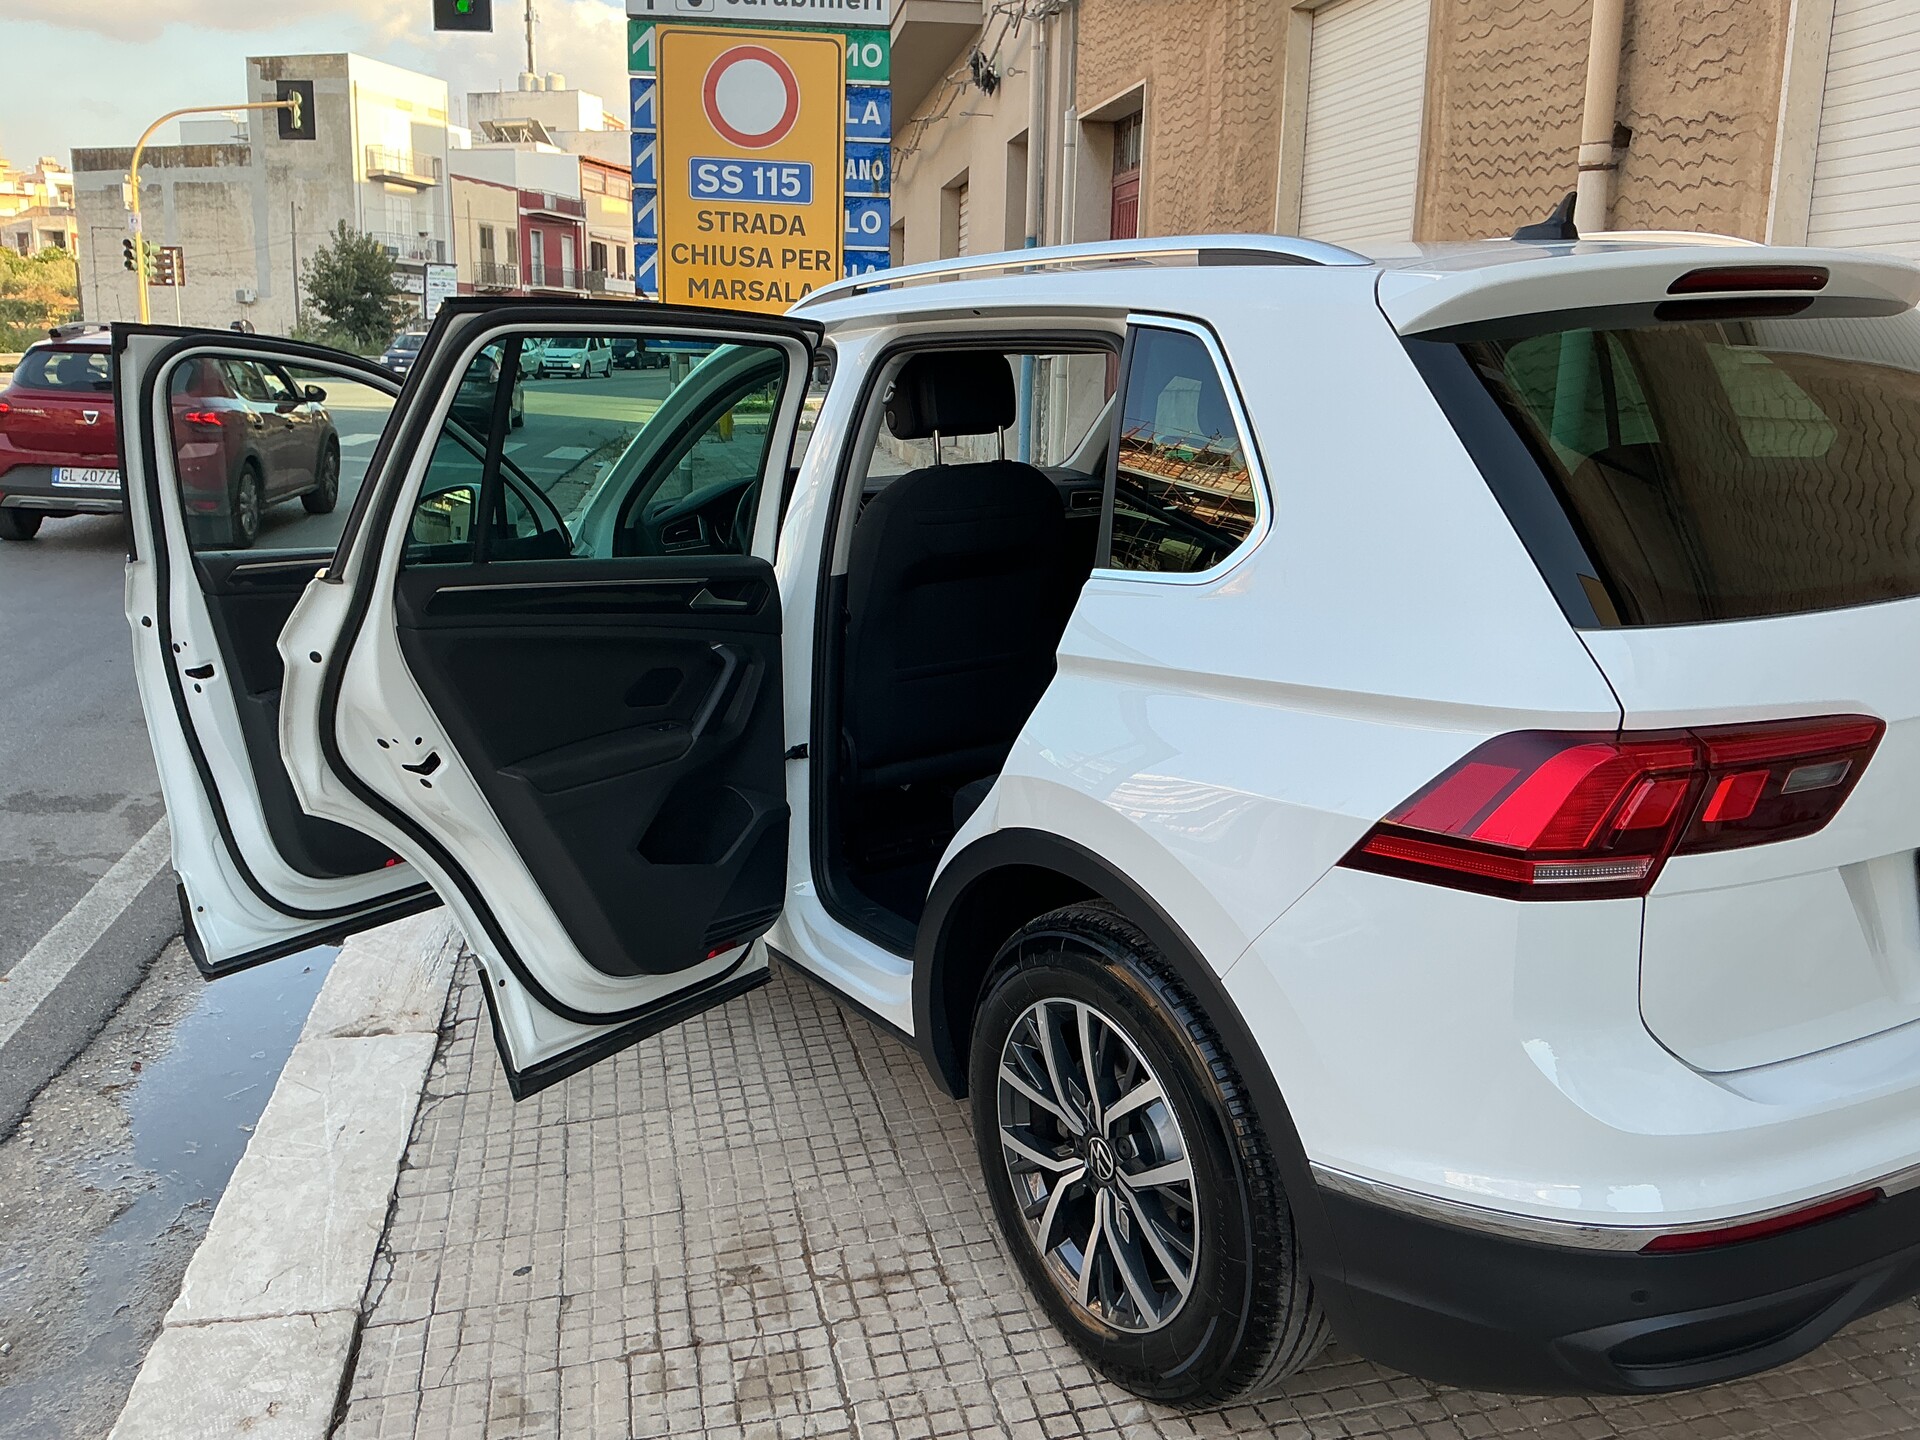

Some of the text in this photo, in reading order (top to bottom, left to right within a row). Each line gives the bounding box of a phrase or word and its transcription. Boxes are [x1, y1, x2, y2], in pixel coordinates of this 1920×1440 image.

[697, 164, 801, 197] SS 115
[697, 210, 806, 236] STRADA
[671, 243, 832, 272] CHIUSA PER
[688, 277, 814, 303] MARSALA
